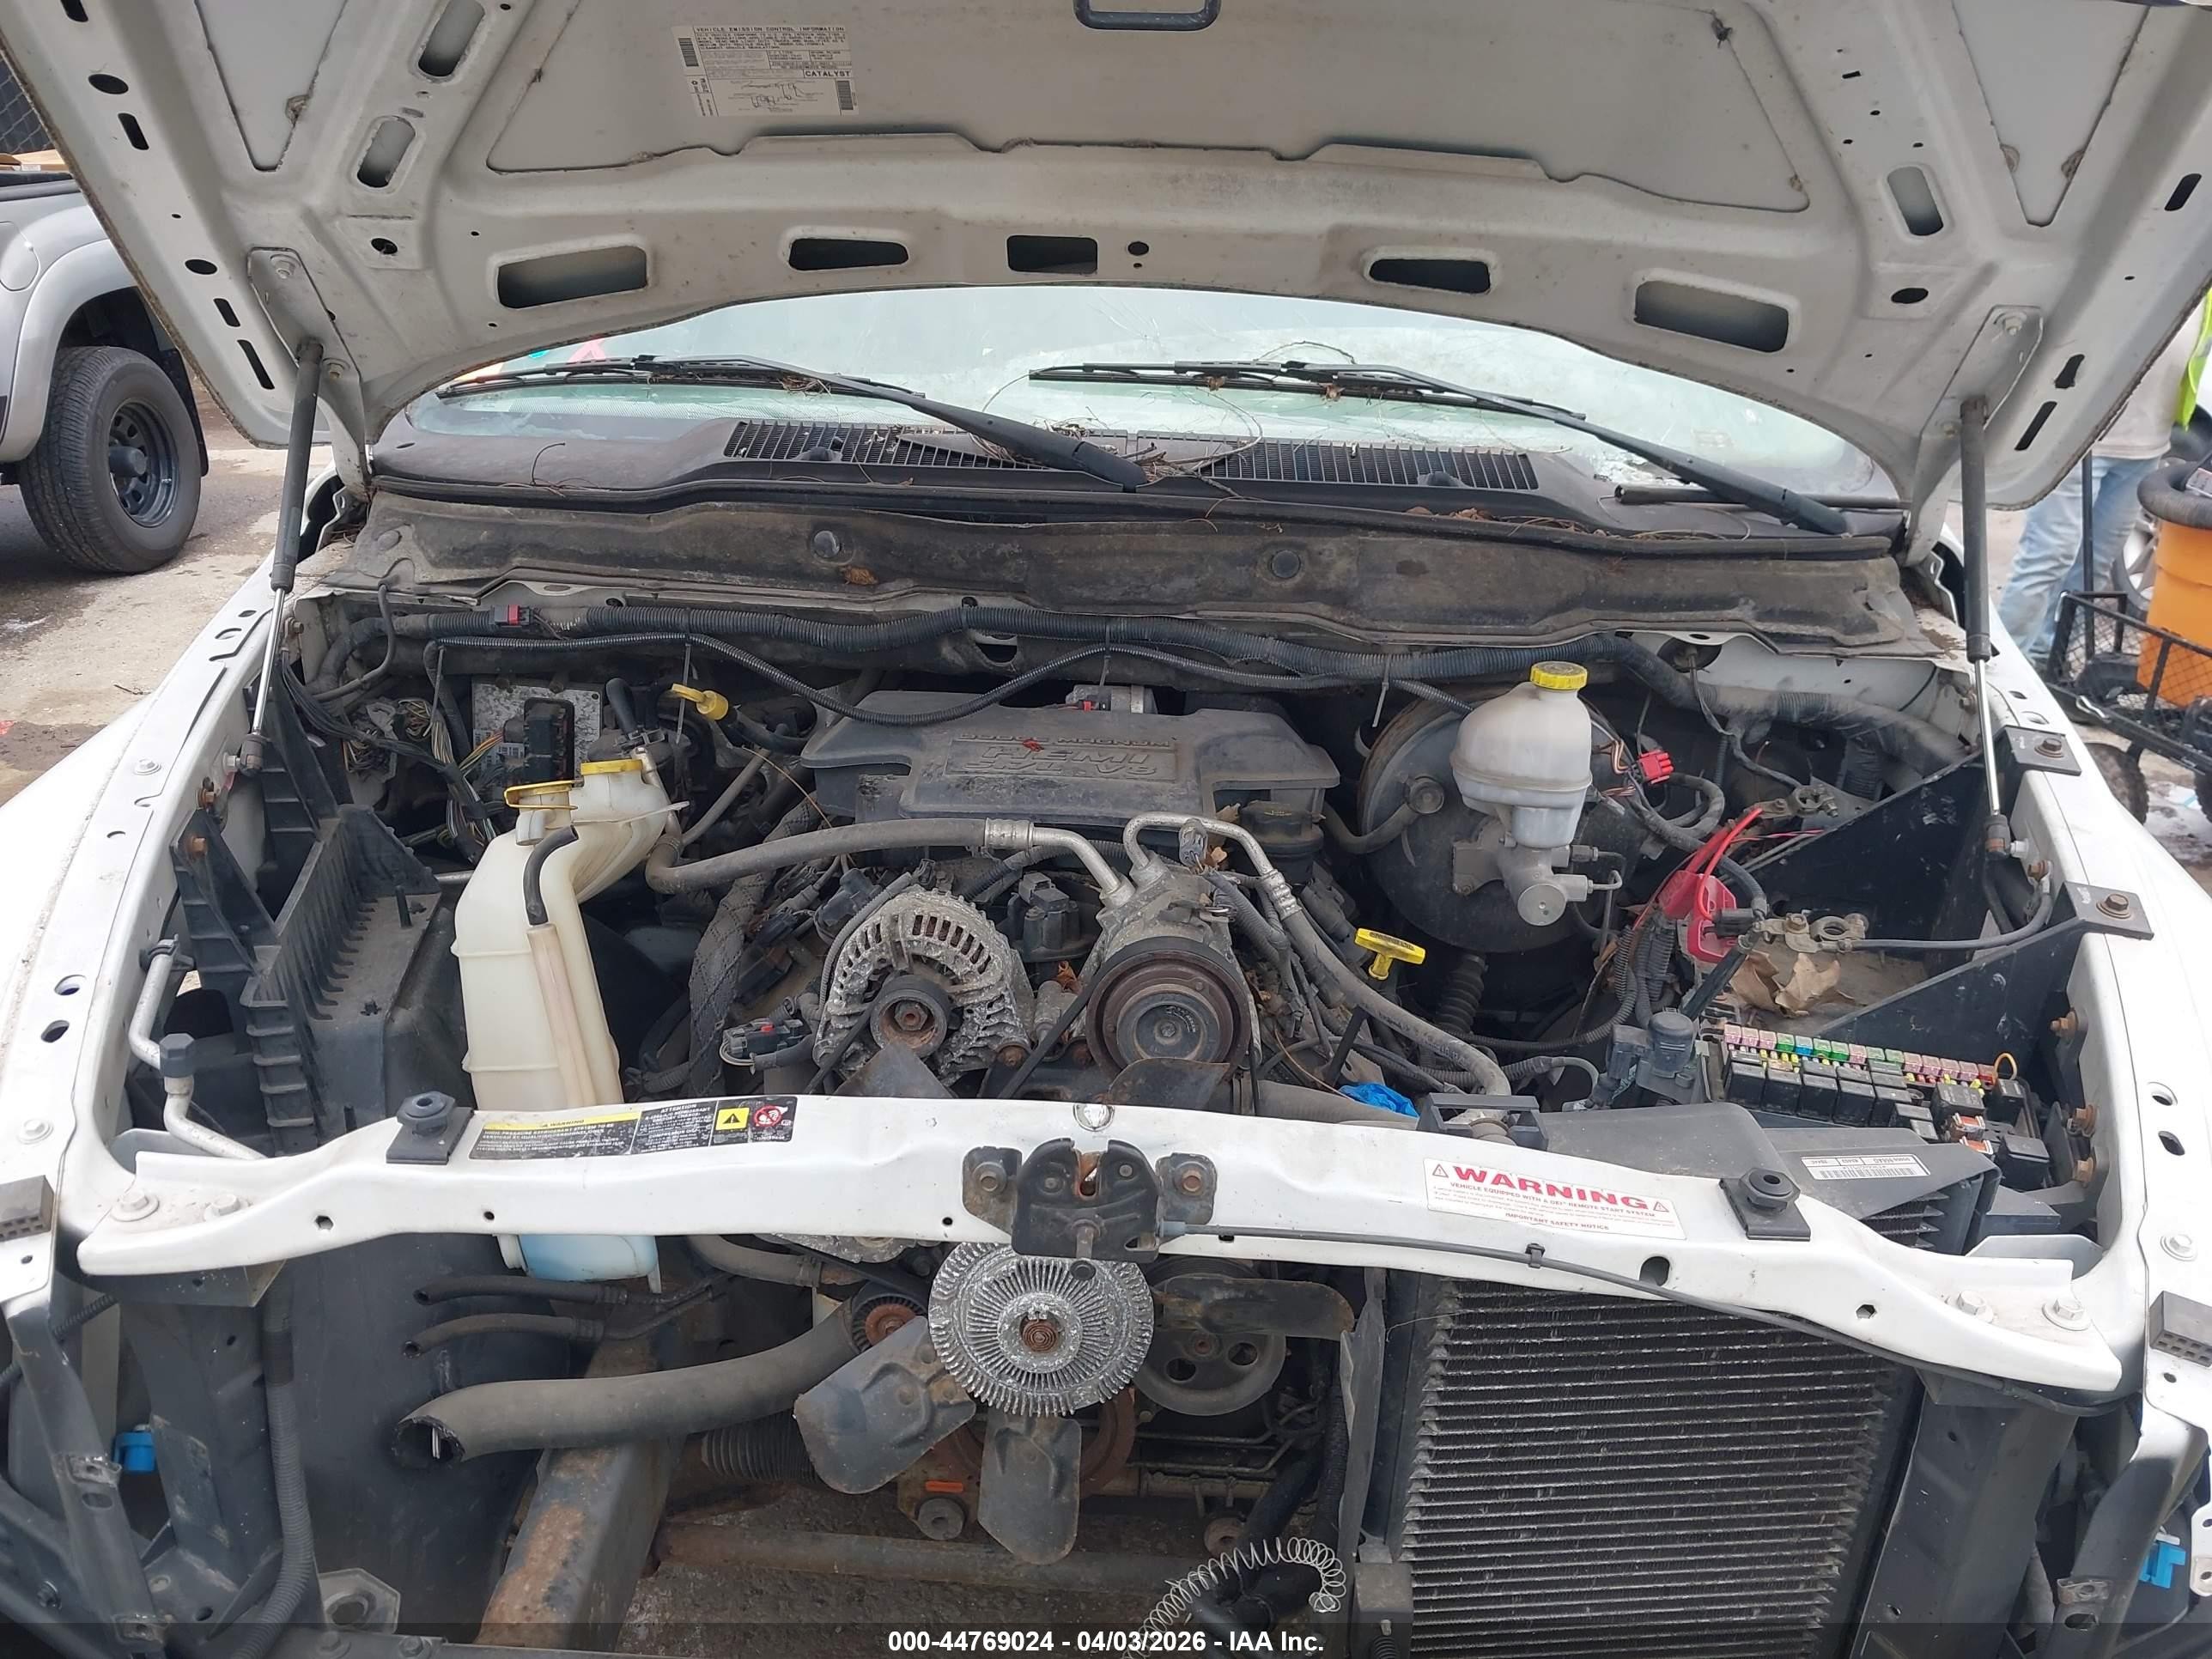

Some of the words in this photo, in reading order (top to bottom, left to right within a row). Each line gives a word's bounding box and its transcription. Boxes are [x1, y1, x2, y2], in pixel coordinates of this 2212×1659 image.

[1058, 738, 1170, 747] MAGNUM
[981, 746, 1150, 763] HEMI
[660, 1103, 697, 1114] ATTENTION
[1450, 1182, 1482, 1191] VEHICLE
[1484, 1188, 1521, 1198] EQUIPPED
[1522, 1194, 1541, 1203] WITH
[1452, 1165, 1649, 1210] WARNING
[1505, 1212, 1548, 1224] IMPORTANT
